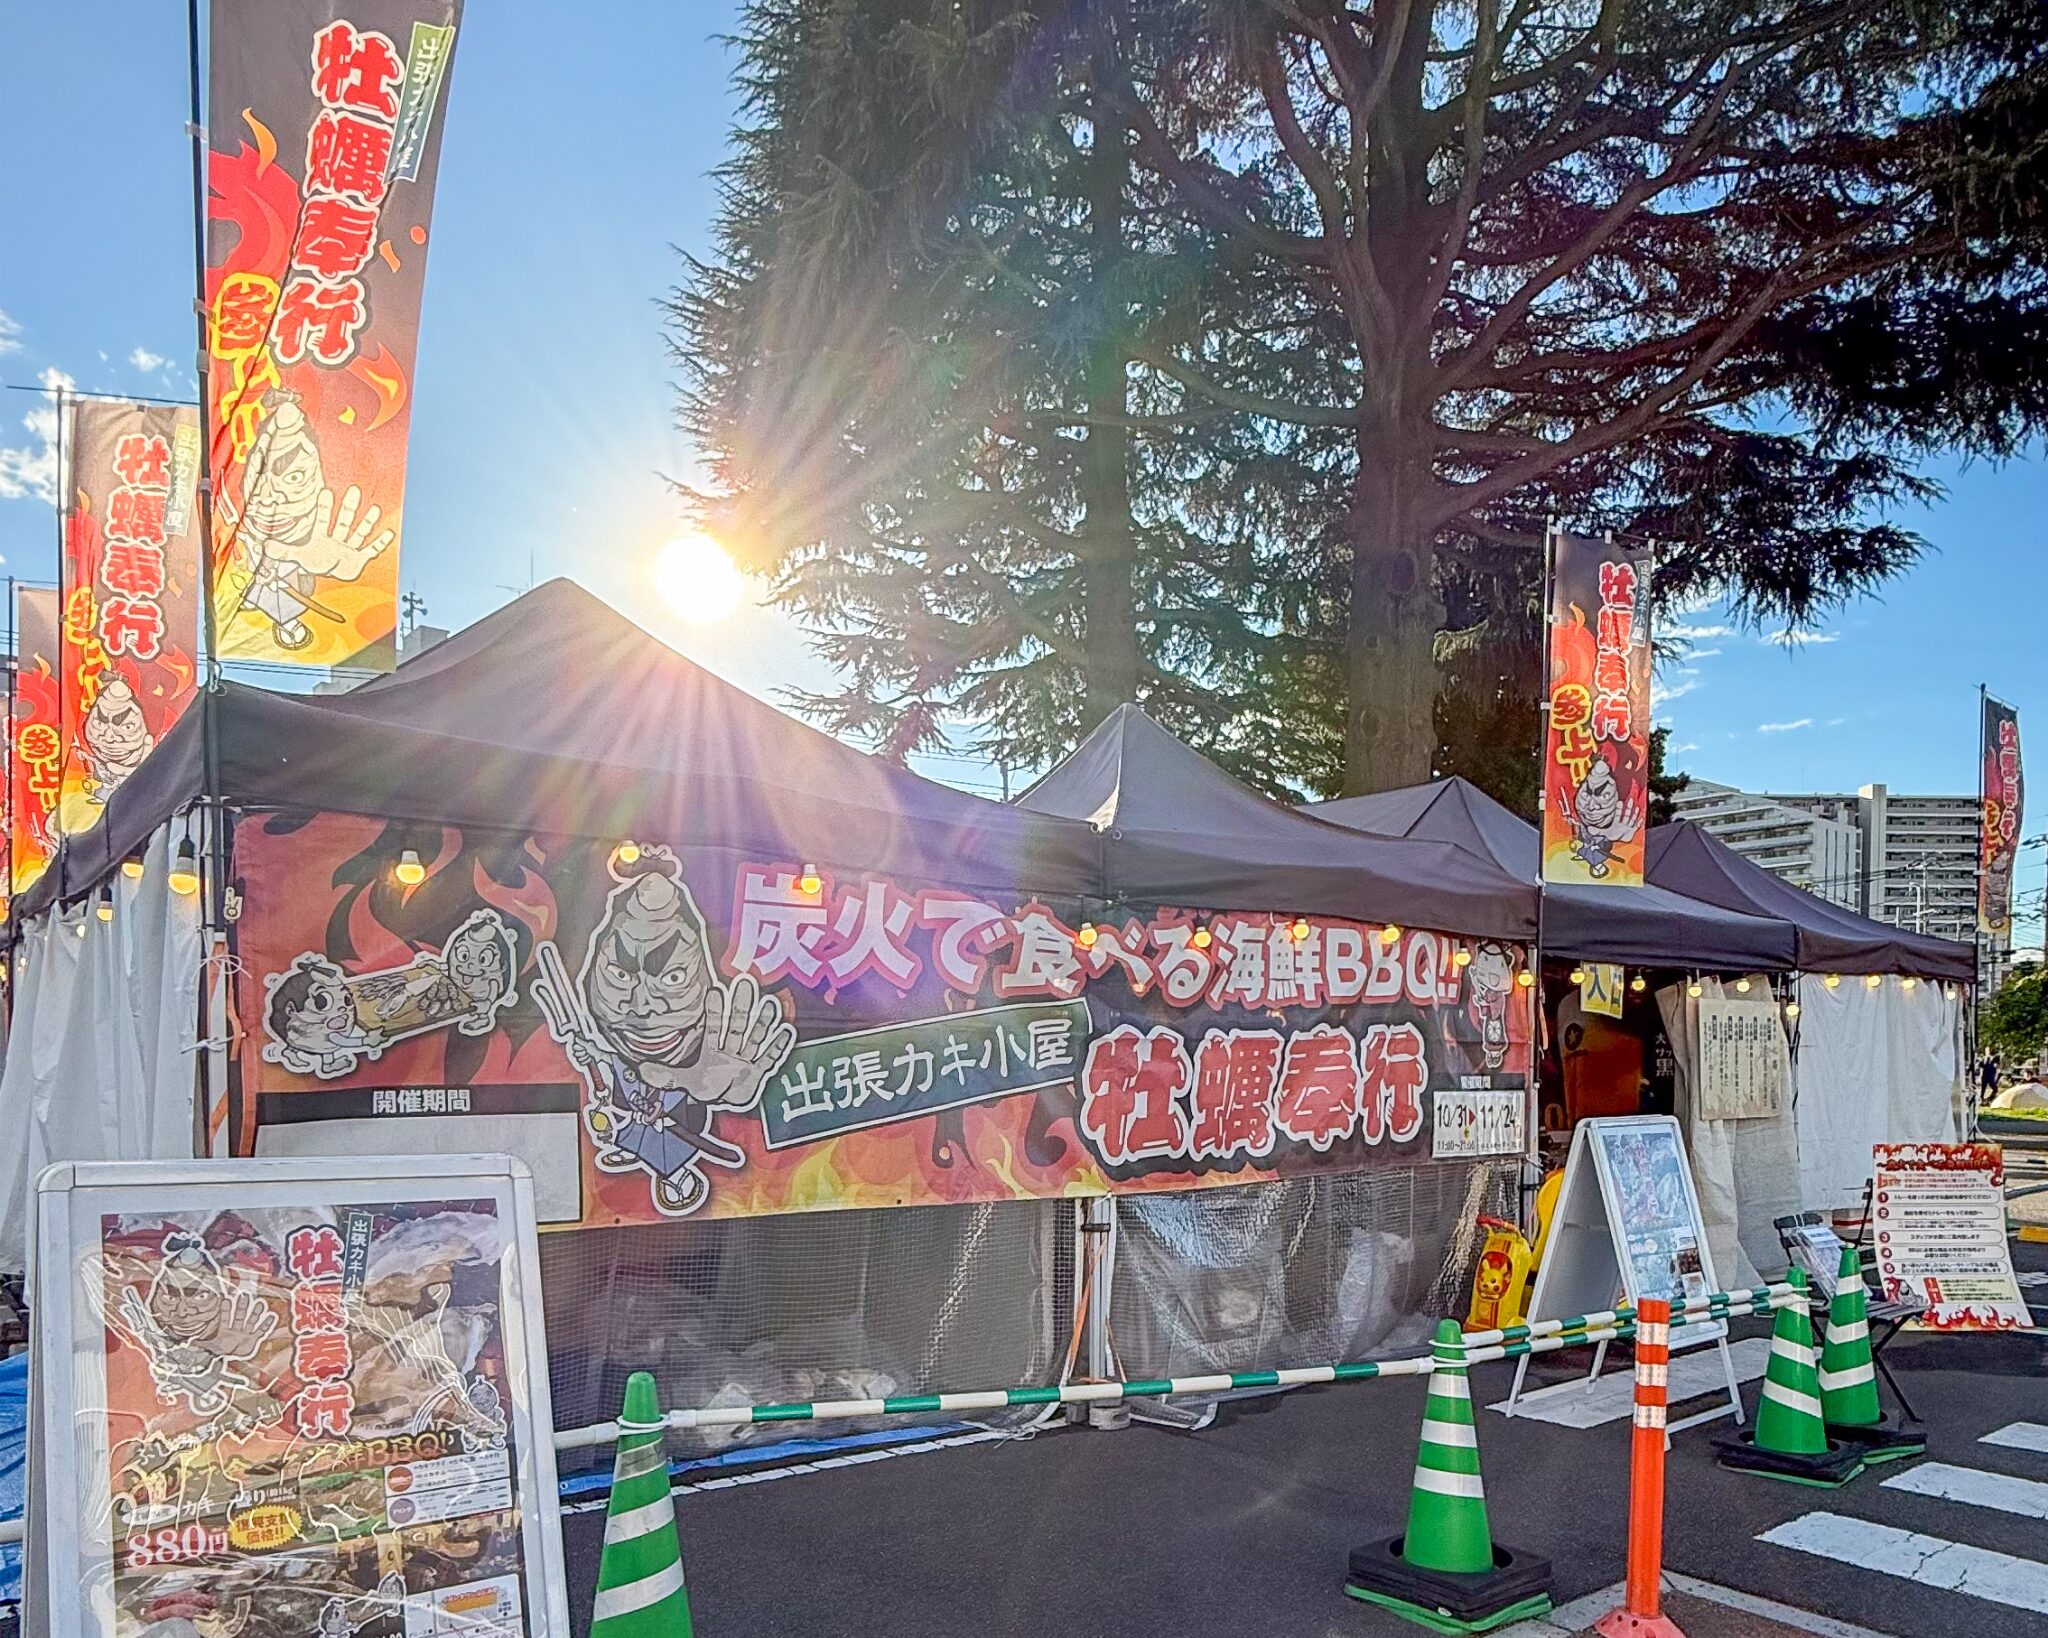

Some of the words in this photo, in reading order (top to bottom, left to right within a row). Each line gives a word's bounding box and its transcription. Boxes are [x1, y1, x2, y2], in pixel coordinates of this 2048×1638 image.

[271, 20, 405, 361] 牡蠣奉行
[101, 432, 170, 661] 牡蠣奉行
[1594, 561, 1637, 742] 牡蠣奉行
[730, 868, 1461, 1001] 炭火で食べる海鮮BBQ!!
[372, 1089, 472, 1114] 開催期間
[779, 1018, 1076, 1124] 出張カキ小屋
[1081, 1022, 1428, 1167] 牡蠣奉行
[1437, 1103, 1467, 1128] 10/31
[1480, 1103, 1516, 1128] 11/24
[288, 1226, 353, 1438] 牡蠣奉行
[127, 1524, 228, 1568] 880円
